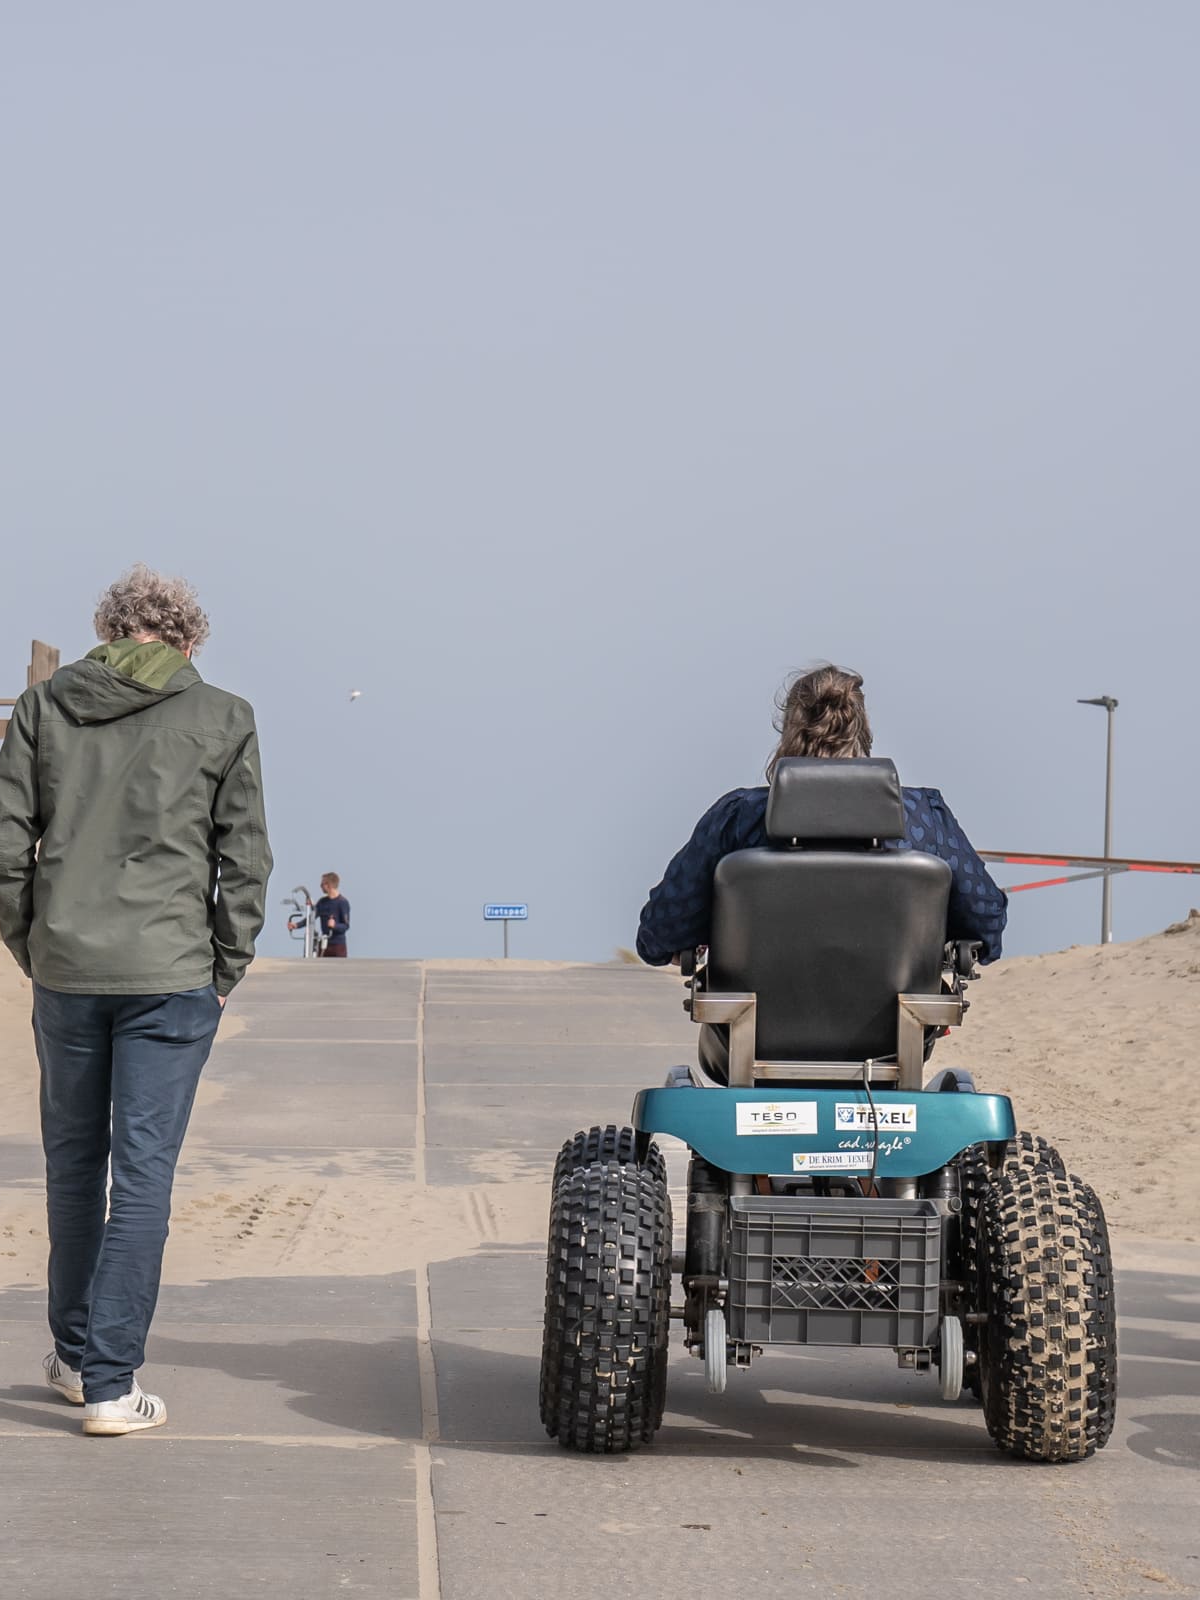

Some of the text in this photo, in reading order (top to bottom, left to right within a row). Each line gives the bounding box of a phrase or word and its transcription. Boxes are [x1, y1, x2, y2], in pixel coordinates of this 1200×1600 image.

[751, 1112, 797, 1121] TESO
[856, 1112, 911, 1124] TEXEL
[809, 1155, 820, 1165] DE
[822, 1153, 842, 1164] KRIM
